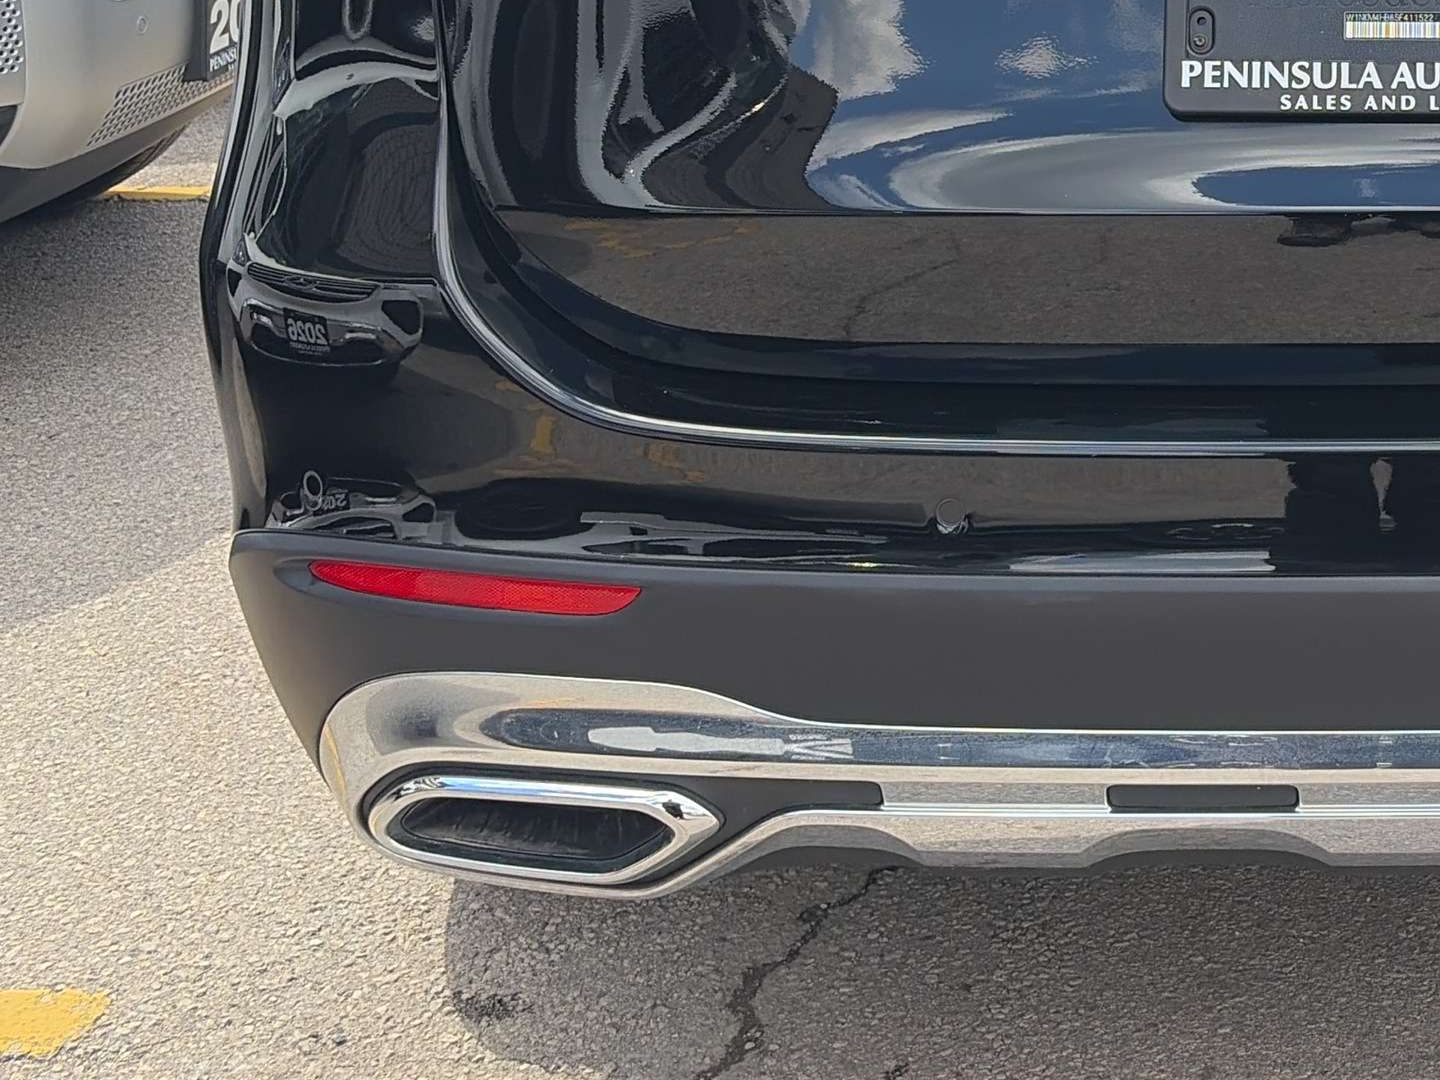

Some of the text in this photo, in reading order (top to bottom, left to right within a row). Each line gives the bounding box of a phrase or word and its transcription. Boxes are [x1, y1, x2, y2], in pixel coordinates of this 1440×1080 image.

[1180, 60, 1382, 90] PENINSULA
[1280, 95, 1352, 111] SALES
[1364, 95, 1417, 111] AND
